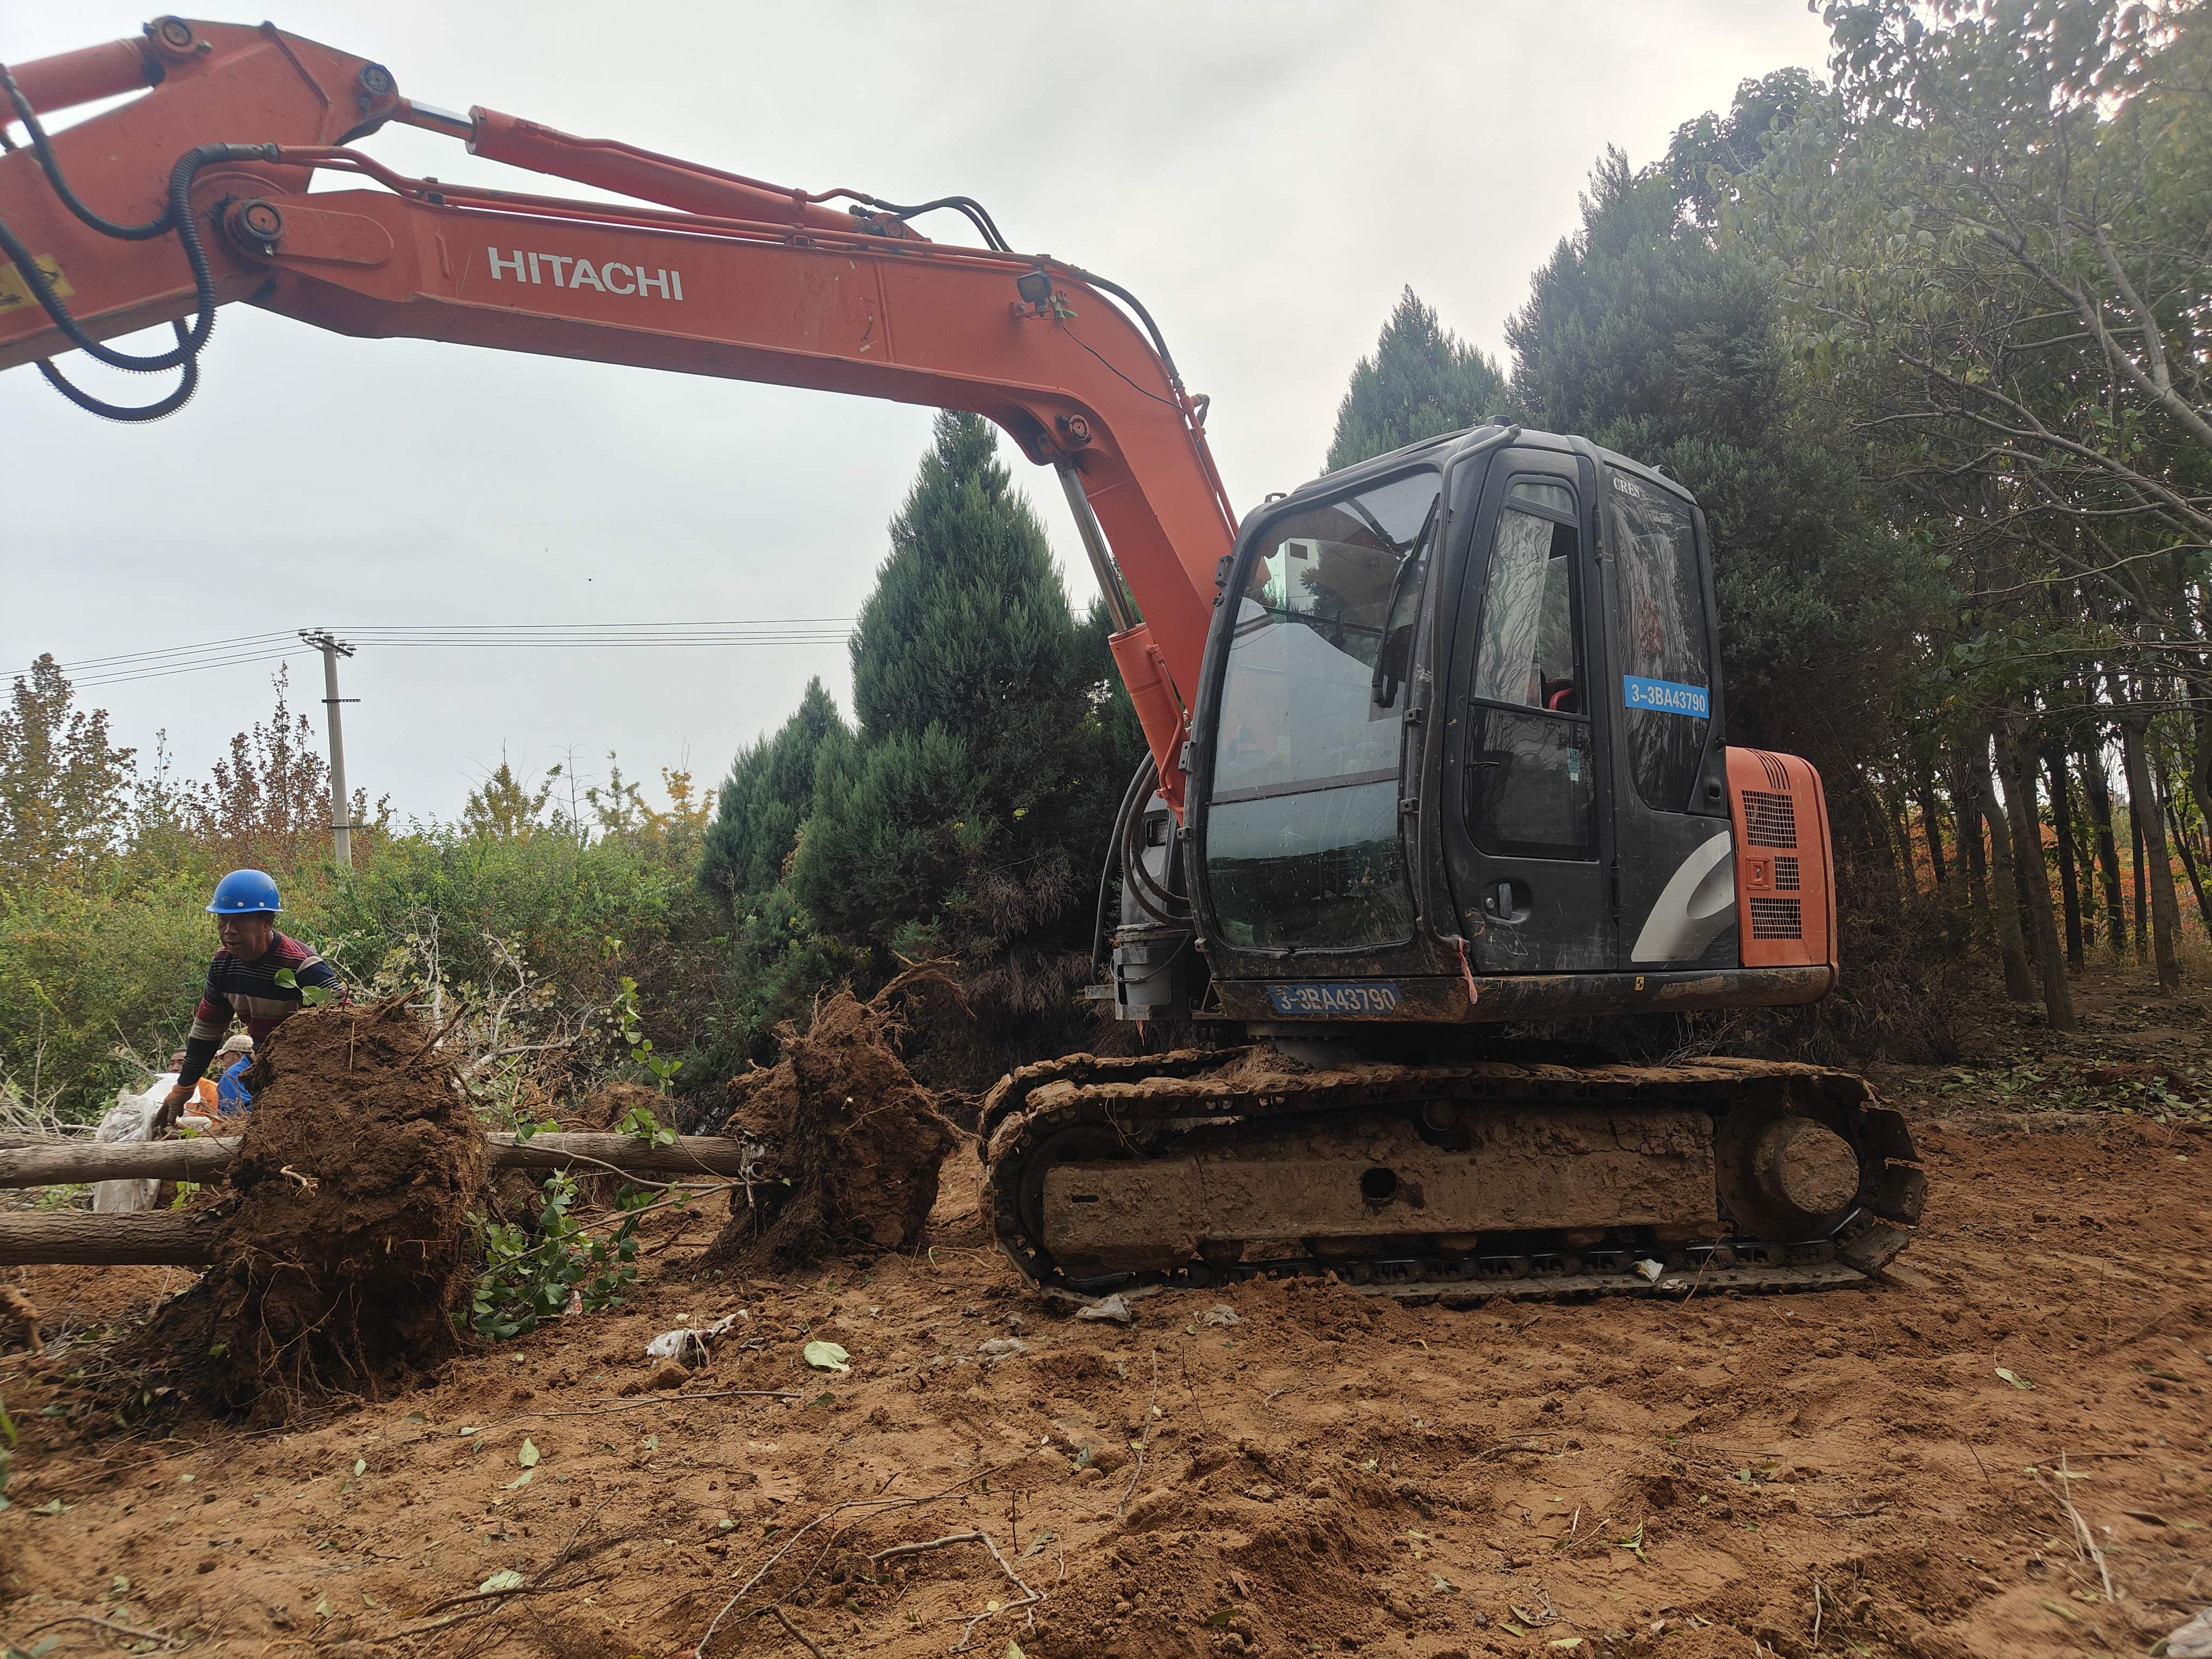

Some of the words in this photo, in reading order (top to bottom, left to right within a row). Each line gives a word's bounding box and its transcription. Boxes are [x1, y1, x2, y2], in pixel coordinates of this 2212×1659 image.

[488, 247, 683, 300] HITACHI
[1613, 477, 1640, 497] CRES
[1631, 684, 1705, 712] 3-3BA43790
[1276, 988, 1396, 1011] 3-3BA43790
